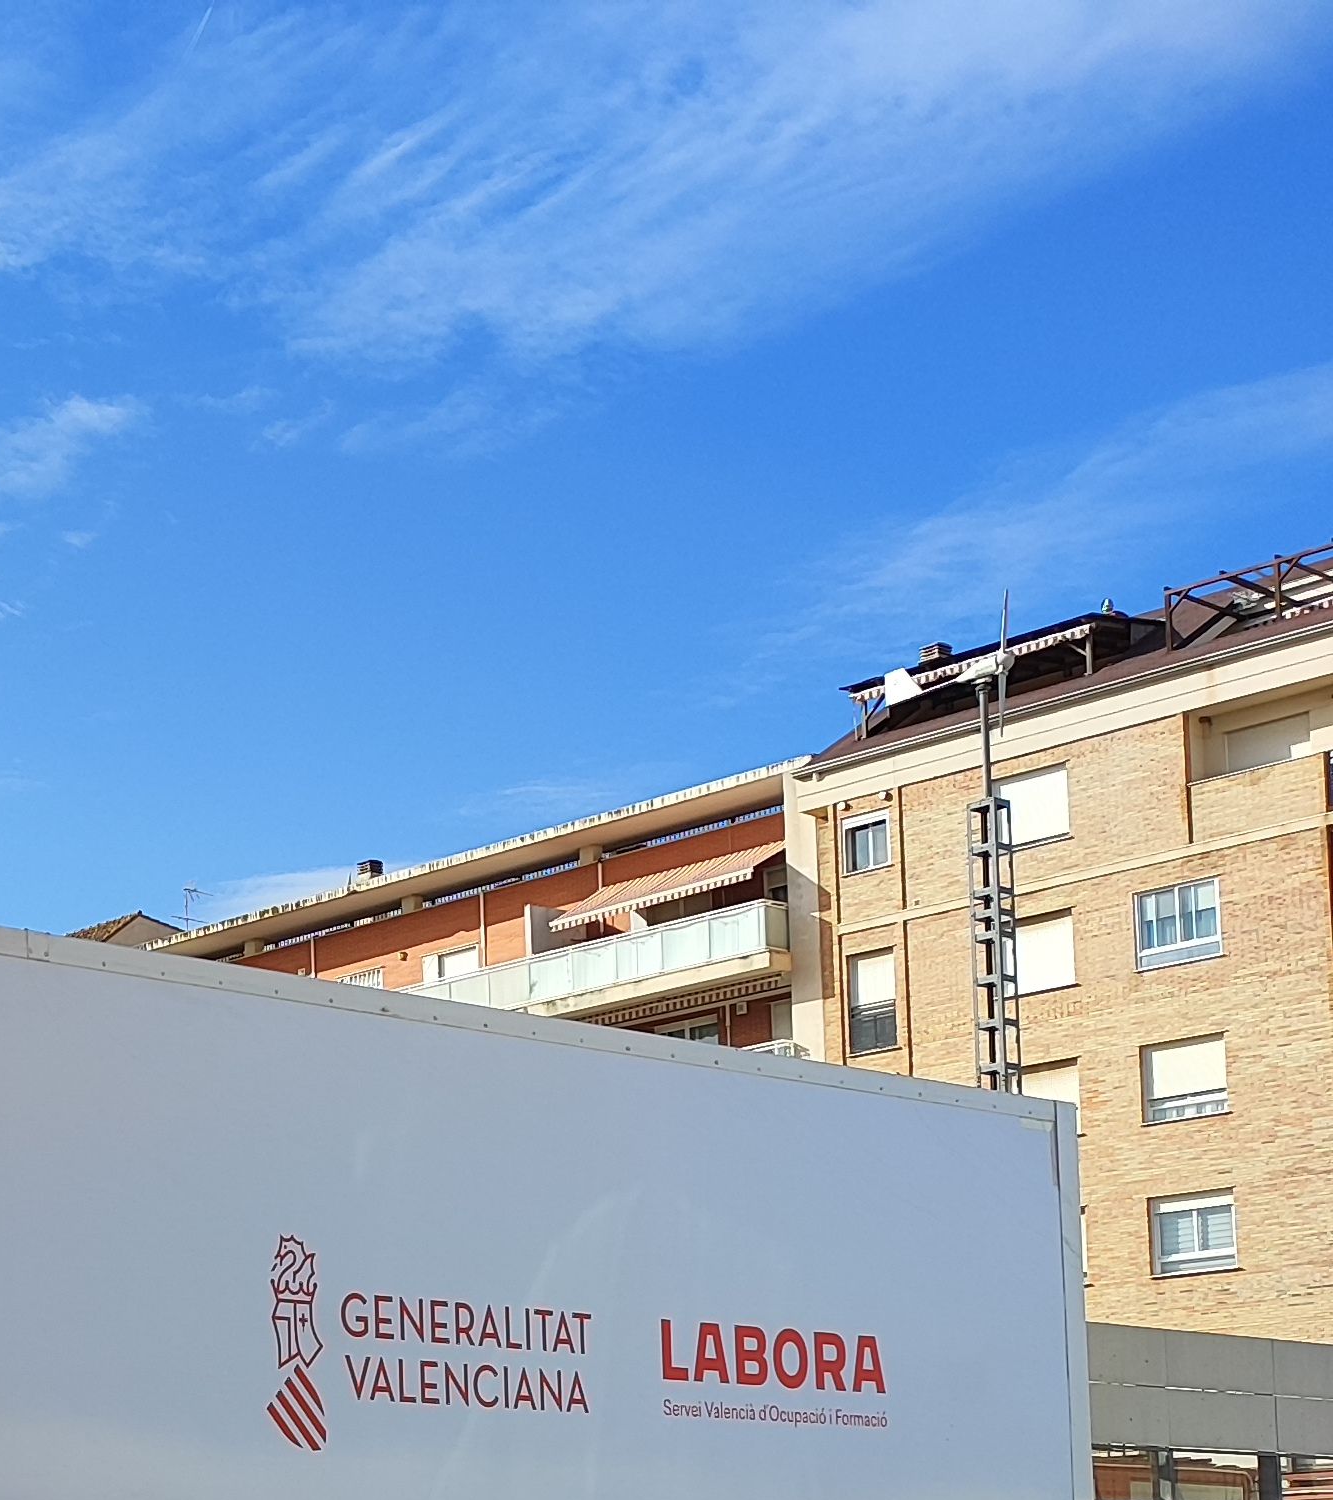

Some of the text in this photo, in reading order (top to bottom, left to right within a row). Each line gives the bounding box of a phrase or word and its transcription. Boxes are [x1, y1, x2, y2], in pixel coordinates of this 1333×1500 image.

[339, 1291, 593, 1356] GENERALITAT
[343, 1354, 591, 1415] VALENCIANA
[659, 1318, 888, 1395] LABORA
[662, 1398, 703, 1419] Servei
[704, 1400, 757, 1422] Valencià
[834, 1408, 889, 1429] Formació
